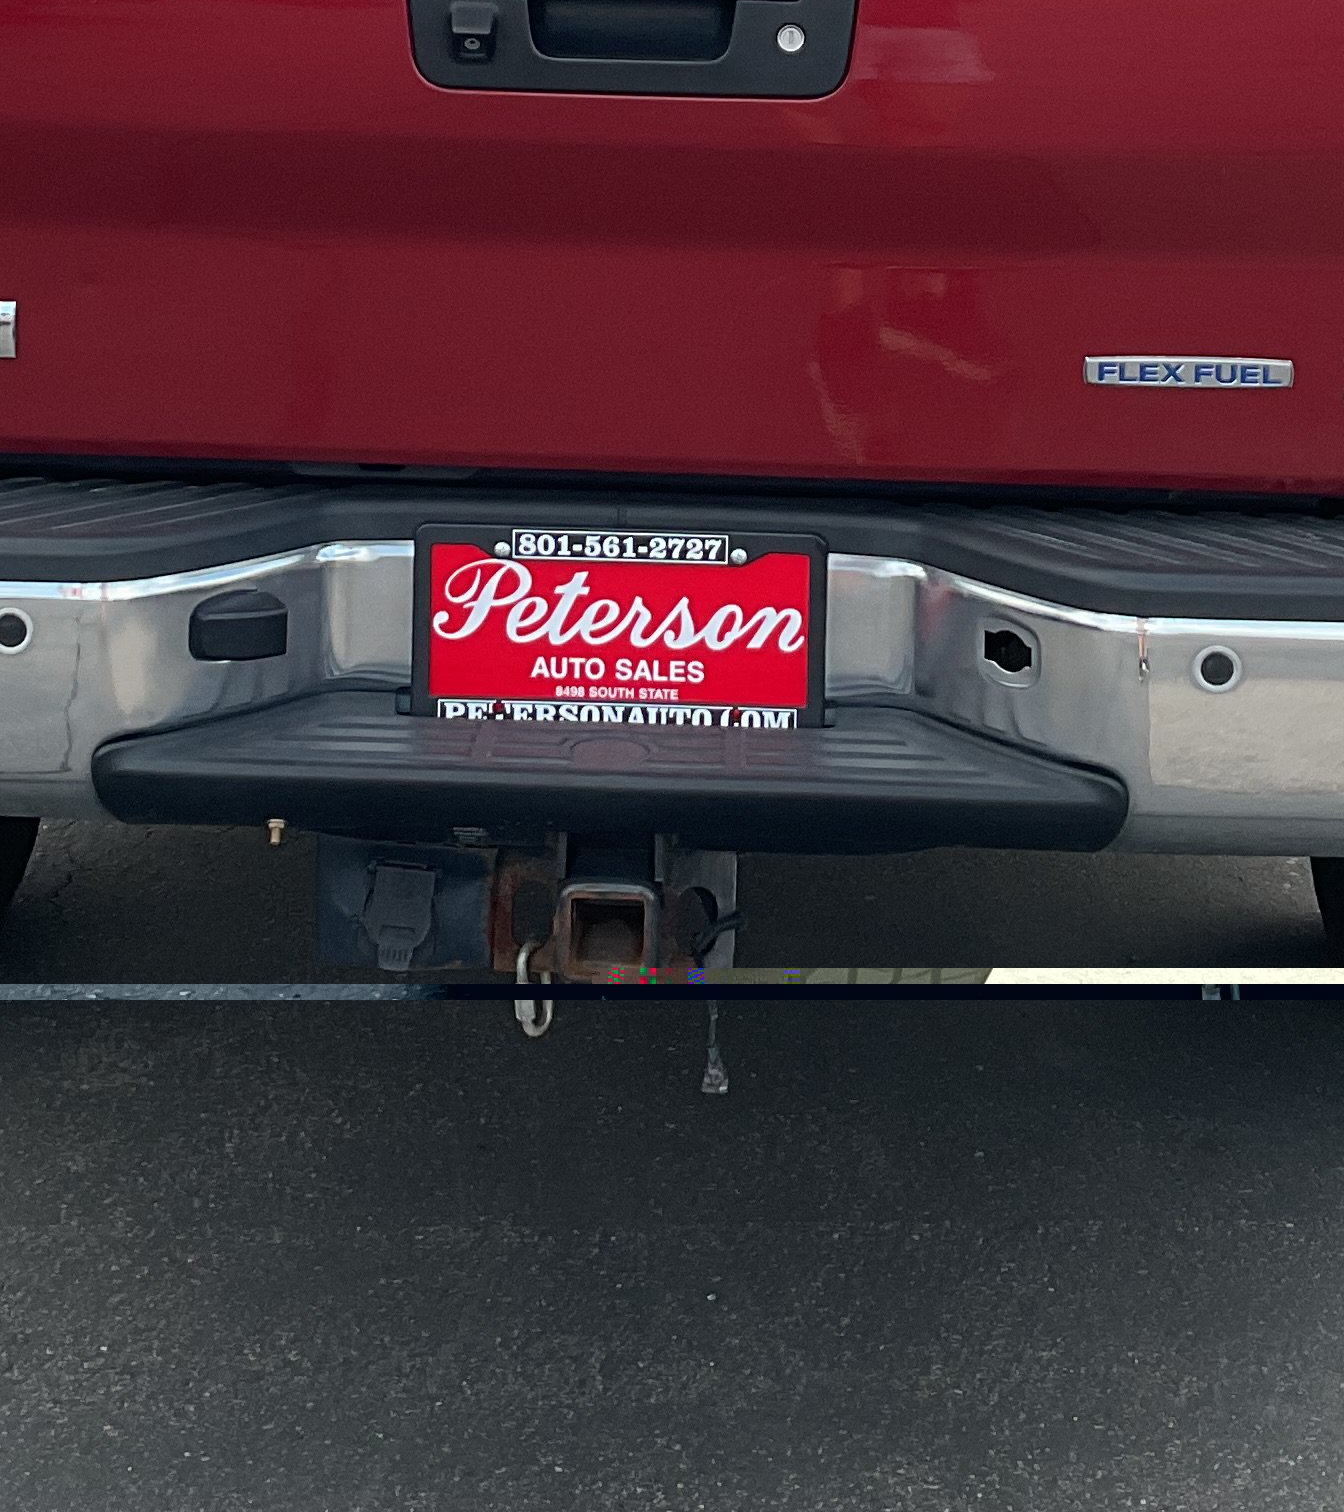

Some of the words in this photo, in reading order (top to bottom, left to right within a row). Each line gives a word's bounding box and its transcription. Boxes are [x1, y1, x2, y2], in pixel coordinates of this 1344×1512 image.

[1097, 361, 1185, 385] FLEX
[1193, 363, 1283, 387] FUEL
[519, 533, 722, 560] 801-561-2727
[432, 558, 806, 654] Peterson
[531, 656, 606, 680] AUTO
[615, 658, 705, 683] SALES
[555, 685, 585, 697] 8498
[589, 686, 634, 699] SOUTH
[638, 687, 679, 700] STATE
[443, 702, 791, 729] PETERSONAUTOCOM
